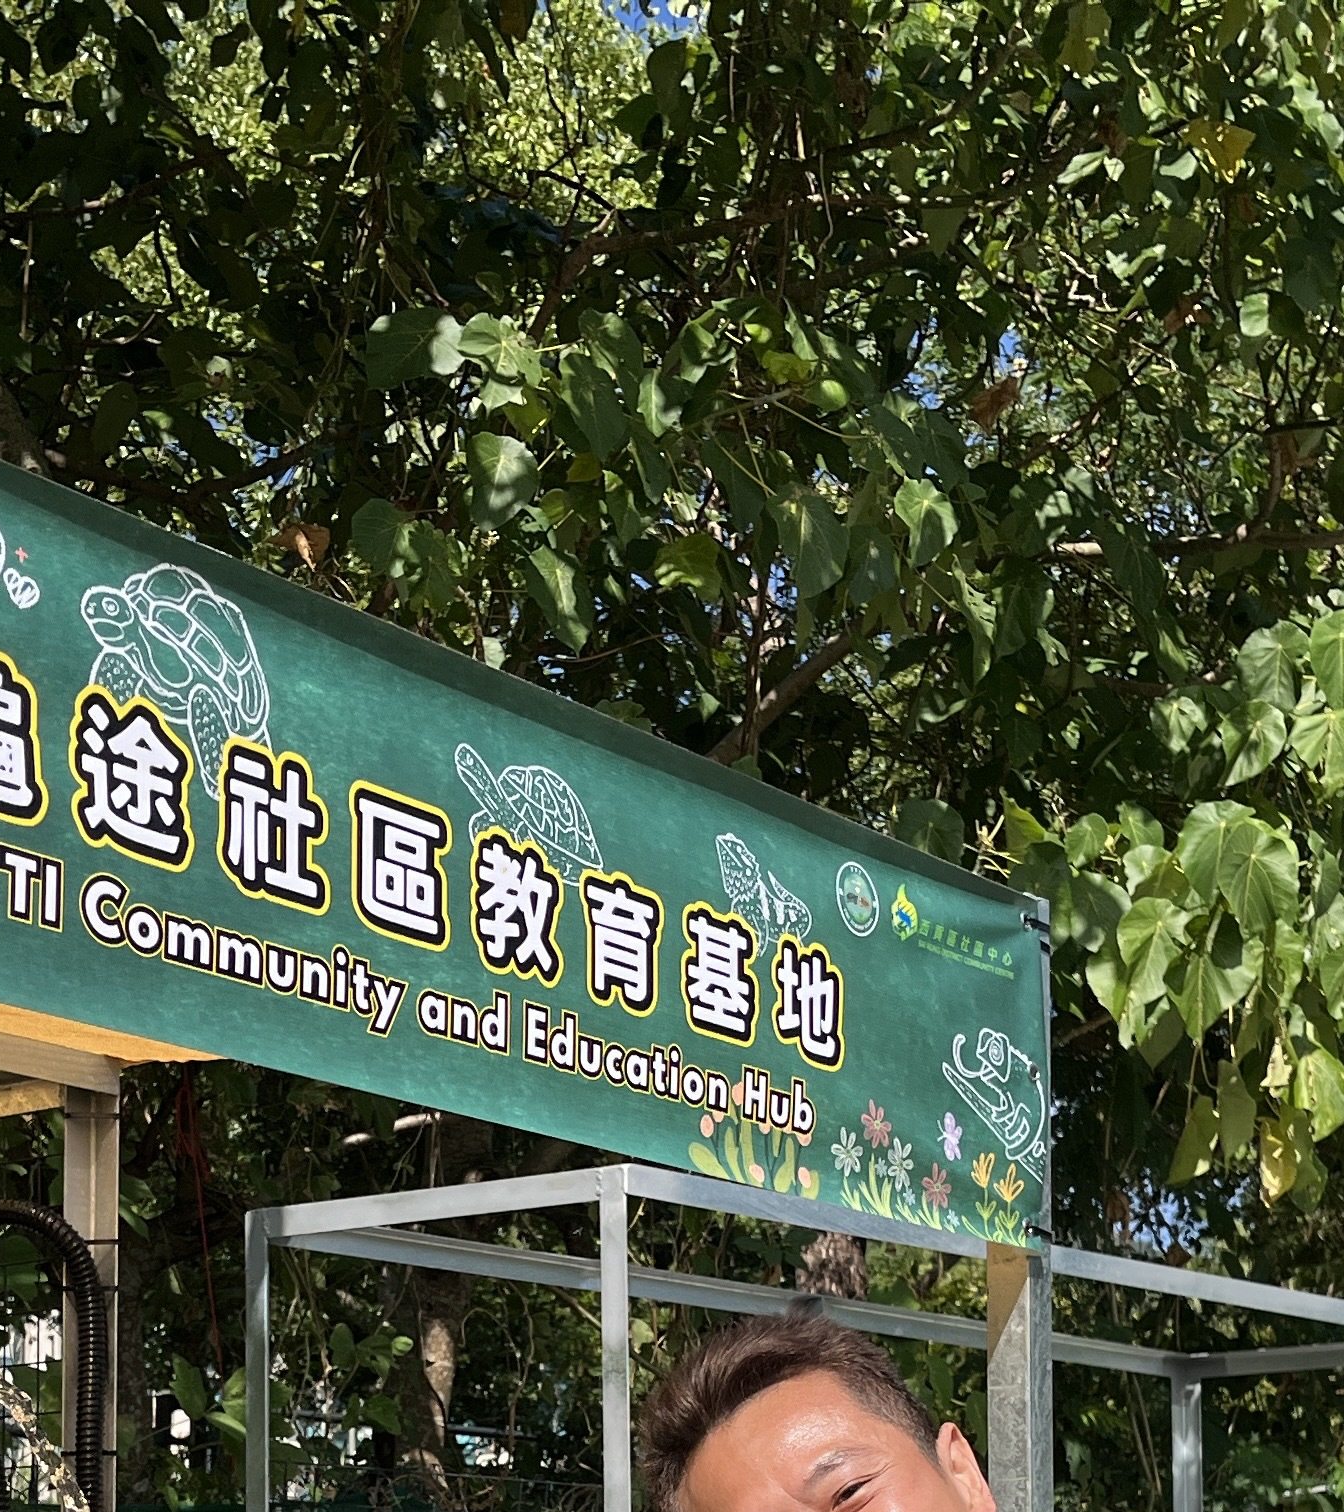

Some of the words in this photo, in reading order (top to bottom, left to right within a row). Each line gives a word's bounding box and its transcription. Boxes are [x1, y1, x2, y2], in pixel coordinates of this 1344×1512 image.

[82, 877, 403, 1033] Community
[420, 992, 509, 1053] and
[525, 1003, 728, 1111] Education
[744, 1068, 813, 1132] Hub
